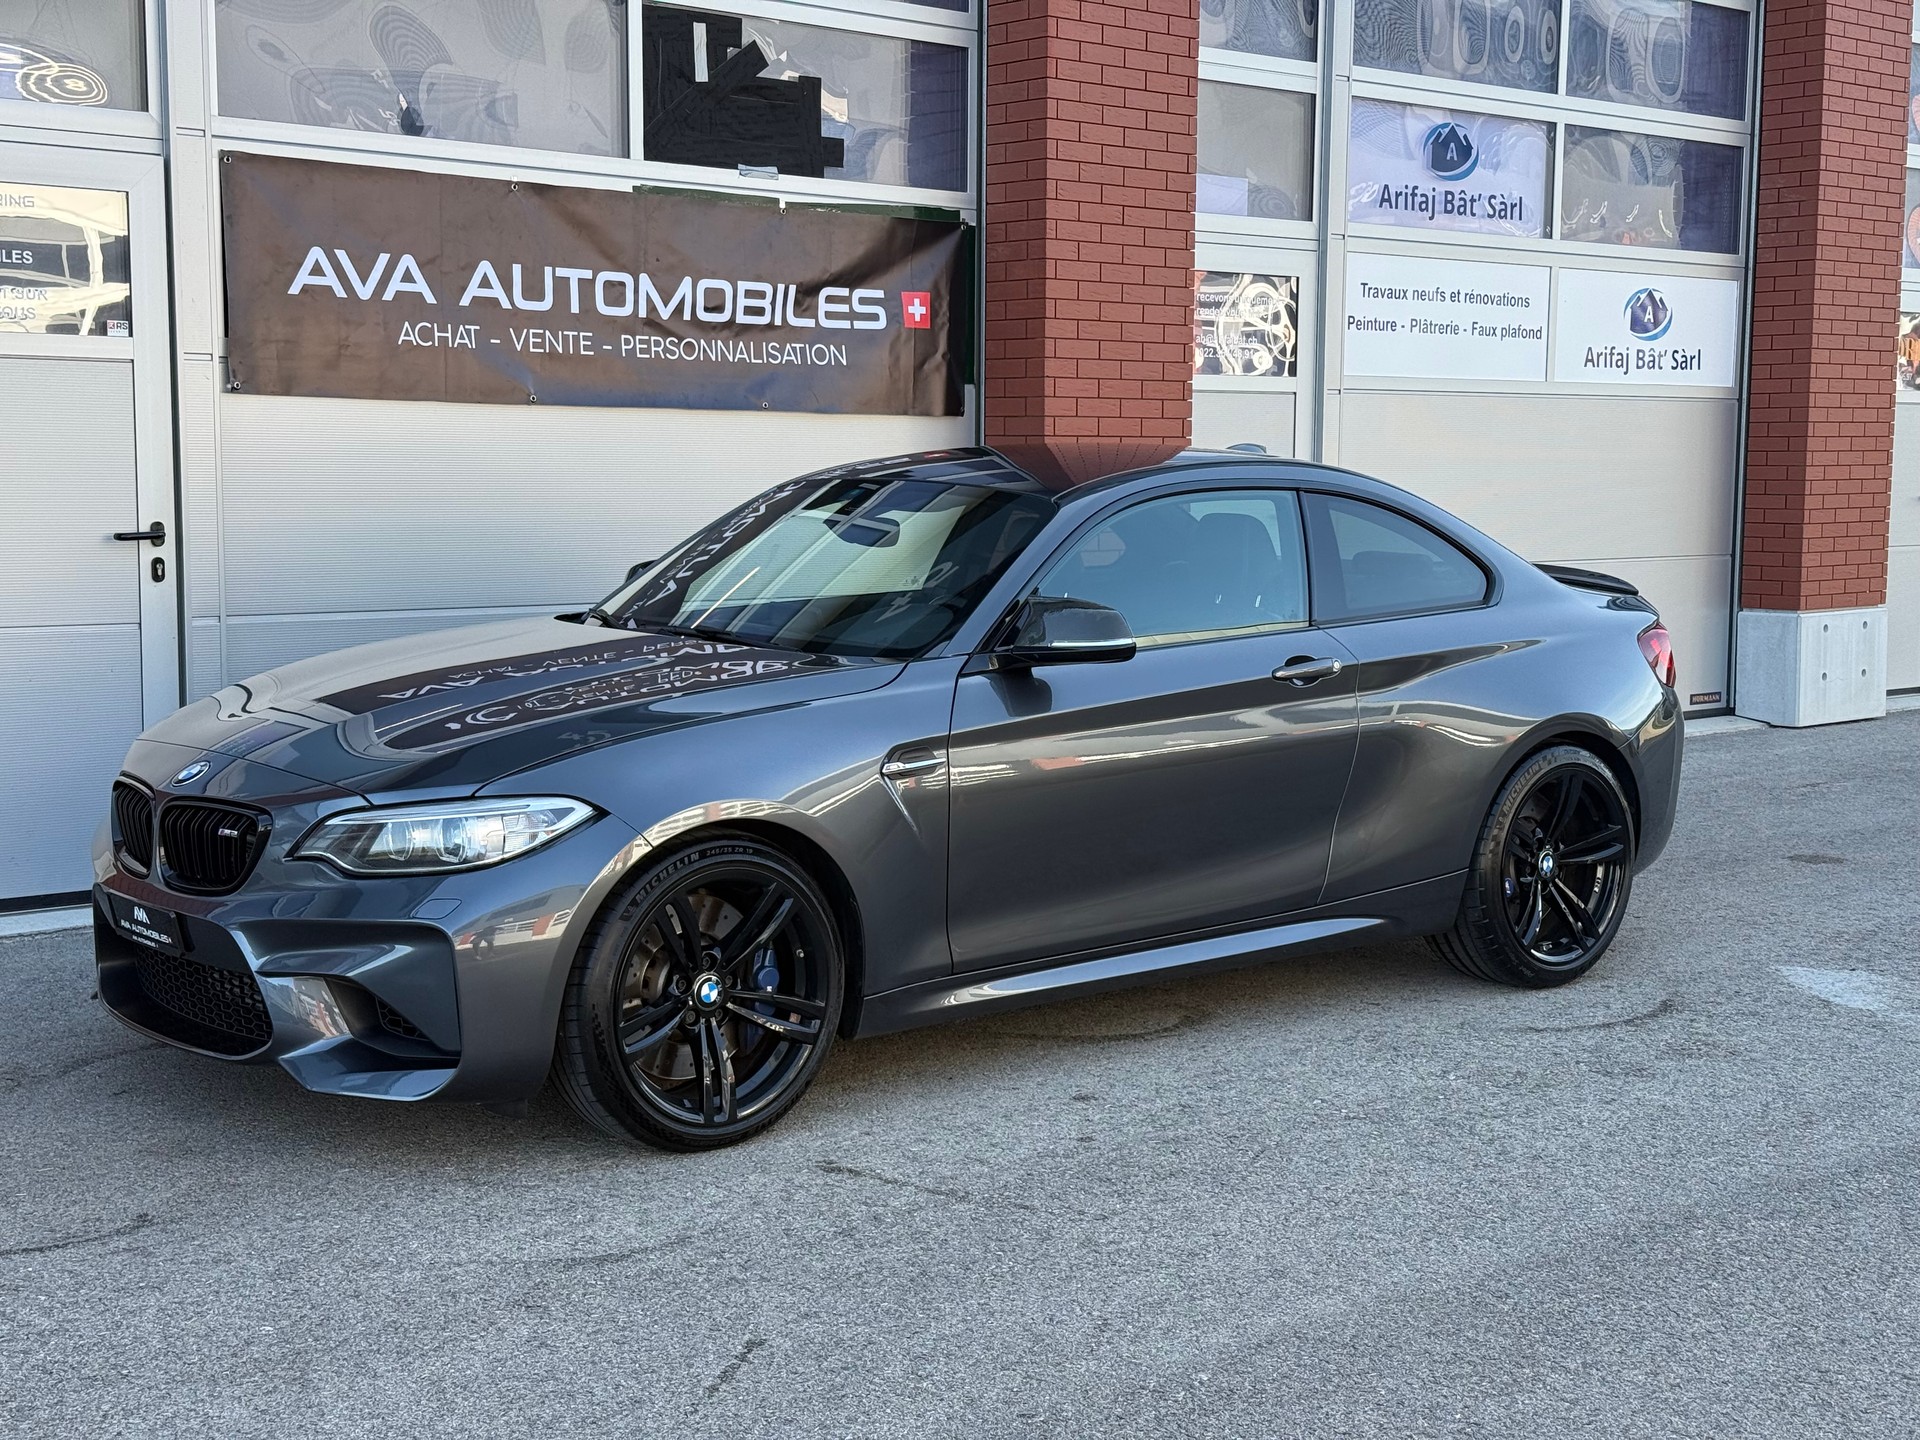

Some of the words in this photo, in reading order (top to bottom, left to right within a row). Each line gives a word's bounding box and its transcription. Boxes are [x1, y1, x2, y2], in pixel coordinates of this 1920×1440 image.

[1379, 184, 1436, 220] Arifaj
[1487, 194, 1523, 221] Sàrl
[287, 246, 437, 304] AVA
[459, 260, 887, 330] AUTOMOBILES
[1361, 282, 1408, 300] Travaux
[1412, 286, 1446, 303] neufs
[1450, 289, 1461, 304] et
[1464, 289, 1530, 308] rénovations
[398, 321, 480, 349] ACHAT
[509, 327, 594, 355] VENTE
[621, 334, 847, 366] PERSONNALISATION
[1347, 315, 1397, 332] Peinture
[1410, 318, 1459, 335] Plâtrerie
[1471, 321, 1497, 338] Faux
[1500, 323, 1543, 341] plafond
[1584, 346, 1630, 375] Arifaj
[1671, 348, 1701, 370] Sàrl
[1502, 761, 1540, 813] MICHELIN
[635, 851, 700, 904] MICHELIN
